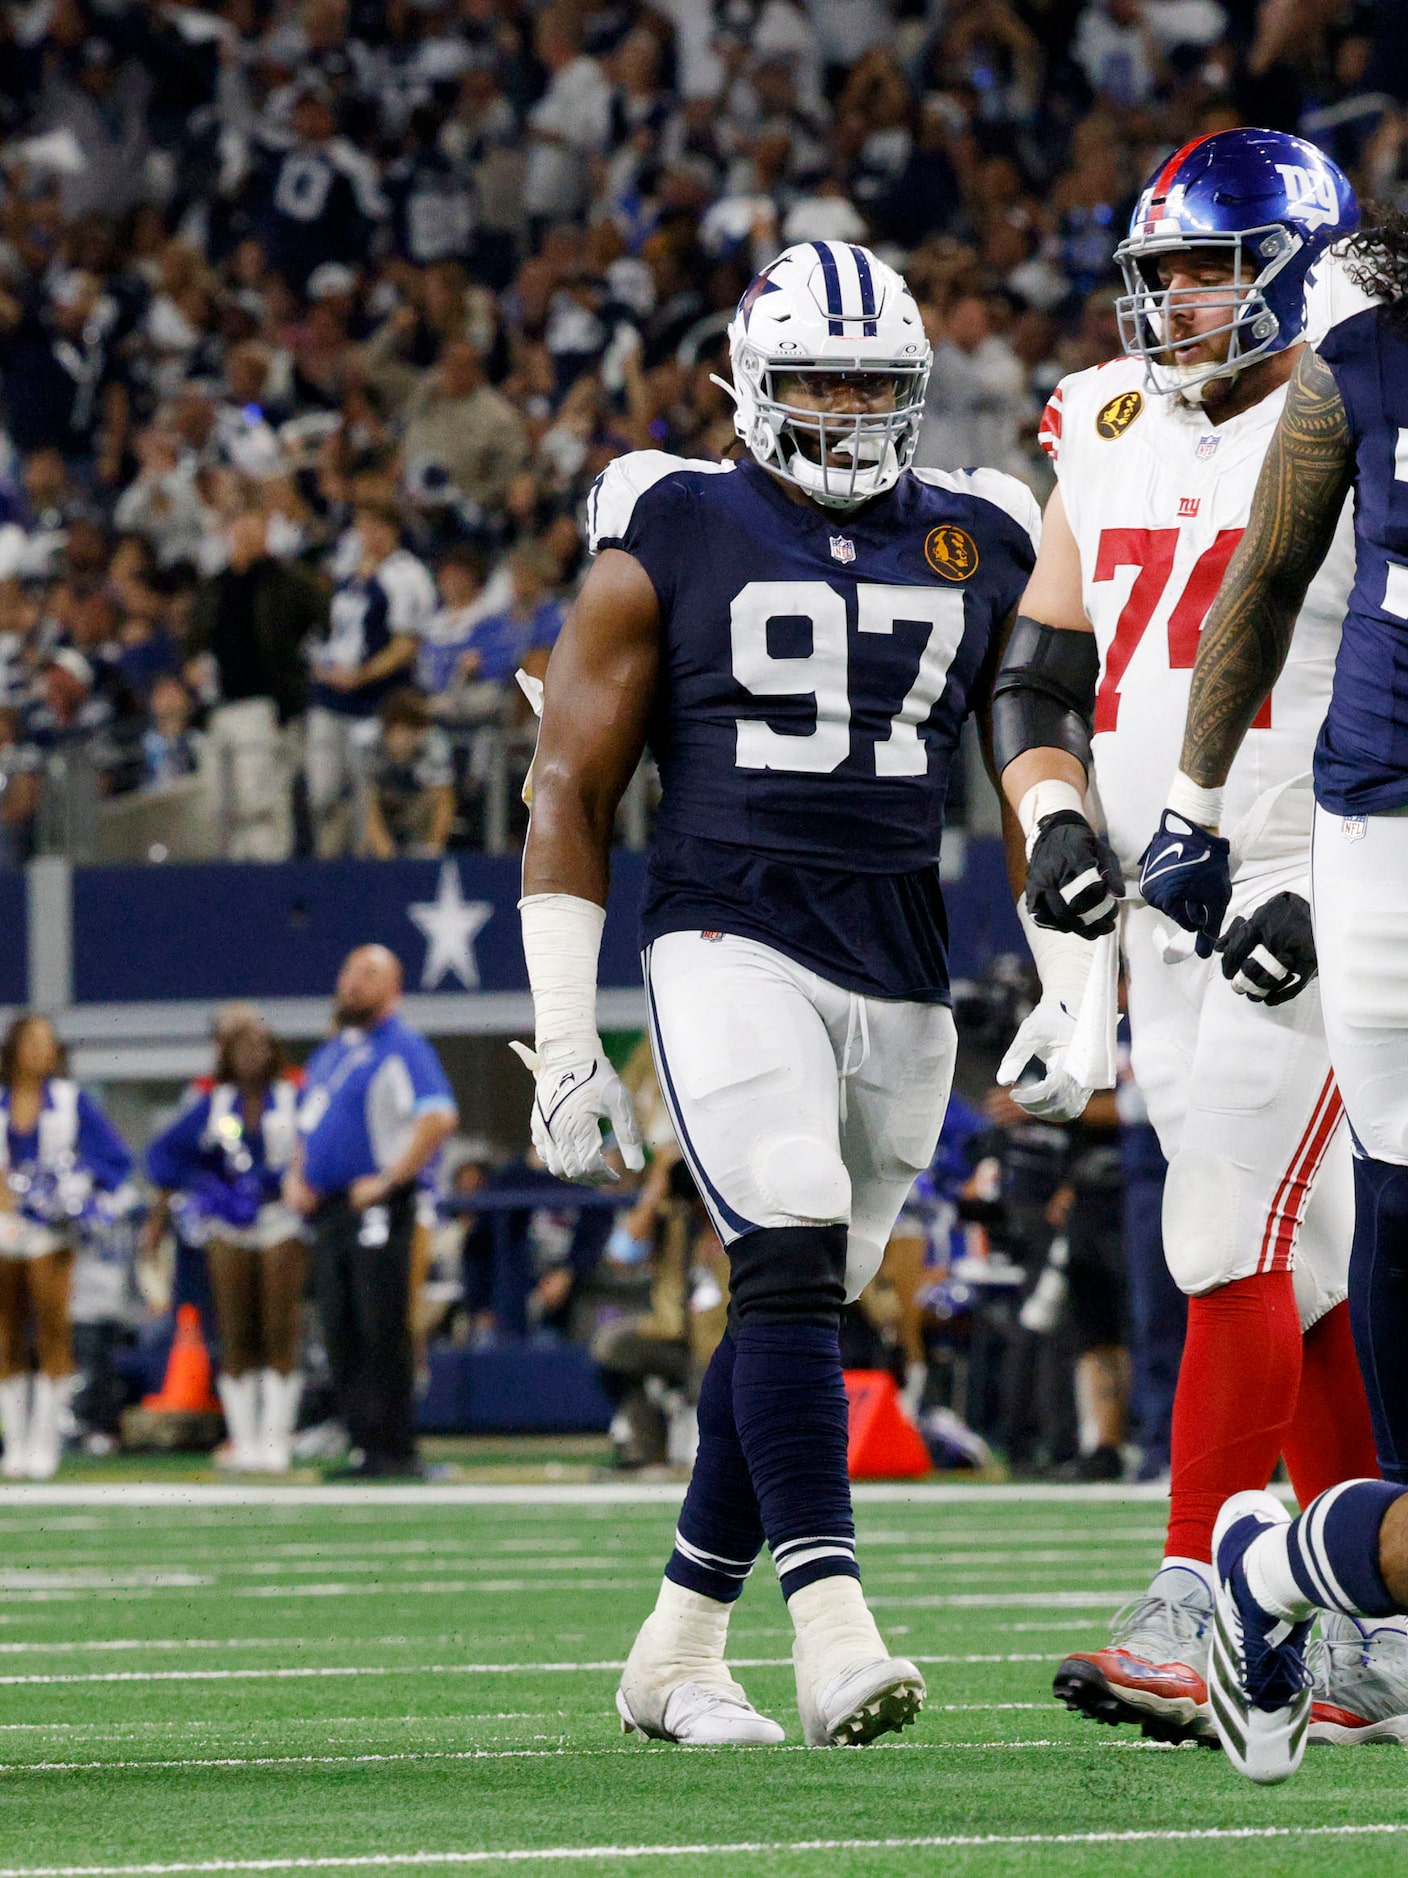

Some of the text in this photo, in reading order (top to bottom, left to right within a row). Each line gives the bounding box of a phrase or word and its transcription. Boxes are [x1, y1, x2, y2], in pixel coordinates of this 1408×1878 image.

[835, 546, 852, 560] NFL
[730, 581, 965, 777] 97
[1344, 822, 1362, 836] NFL
